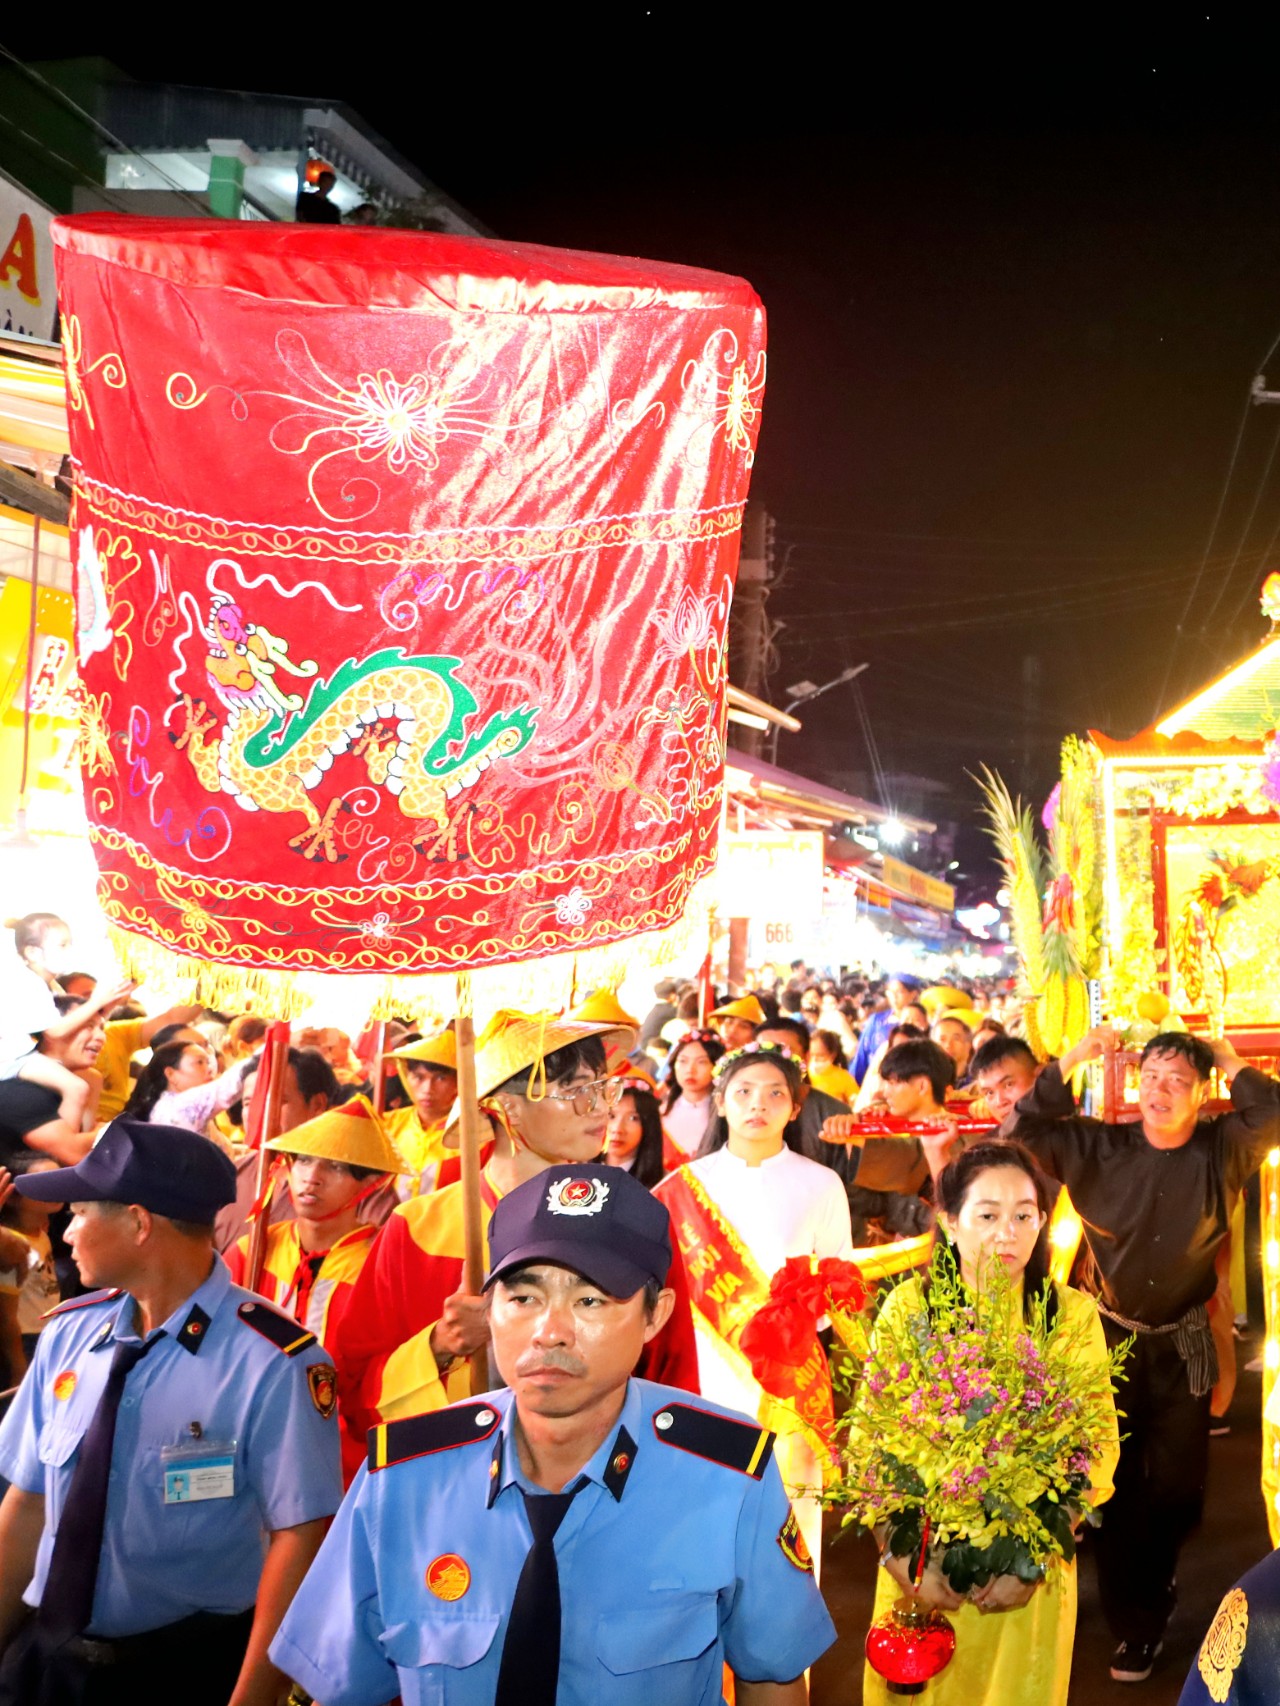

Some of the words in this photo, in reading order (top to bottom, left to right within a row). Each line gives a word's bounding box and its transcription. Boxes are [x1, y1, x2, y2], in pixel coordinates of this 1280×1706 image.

[766, 922, 793, 944] 666
[688, 1244, 721, 1280] HỘI
[705, 1272, 743, 1303] VÍA
